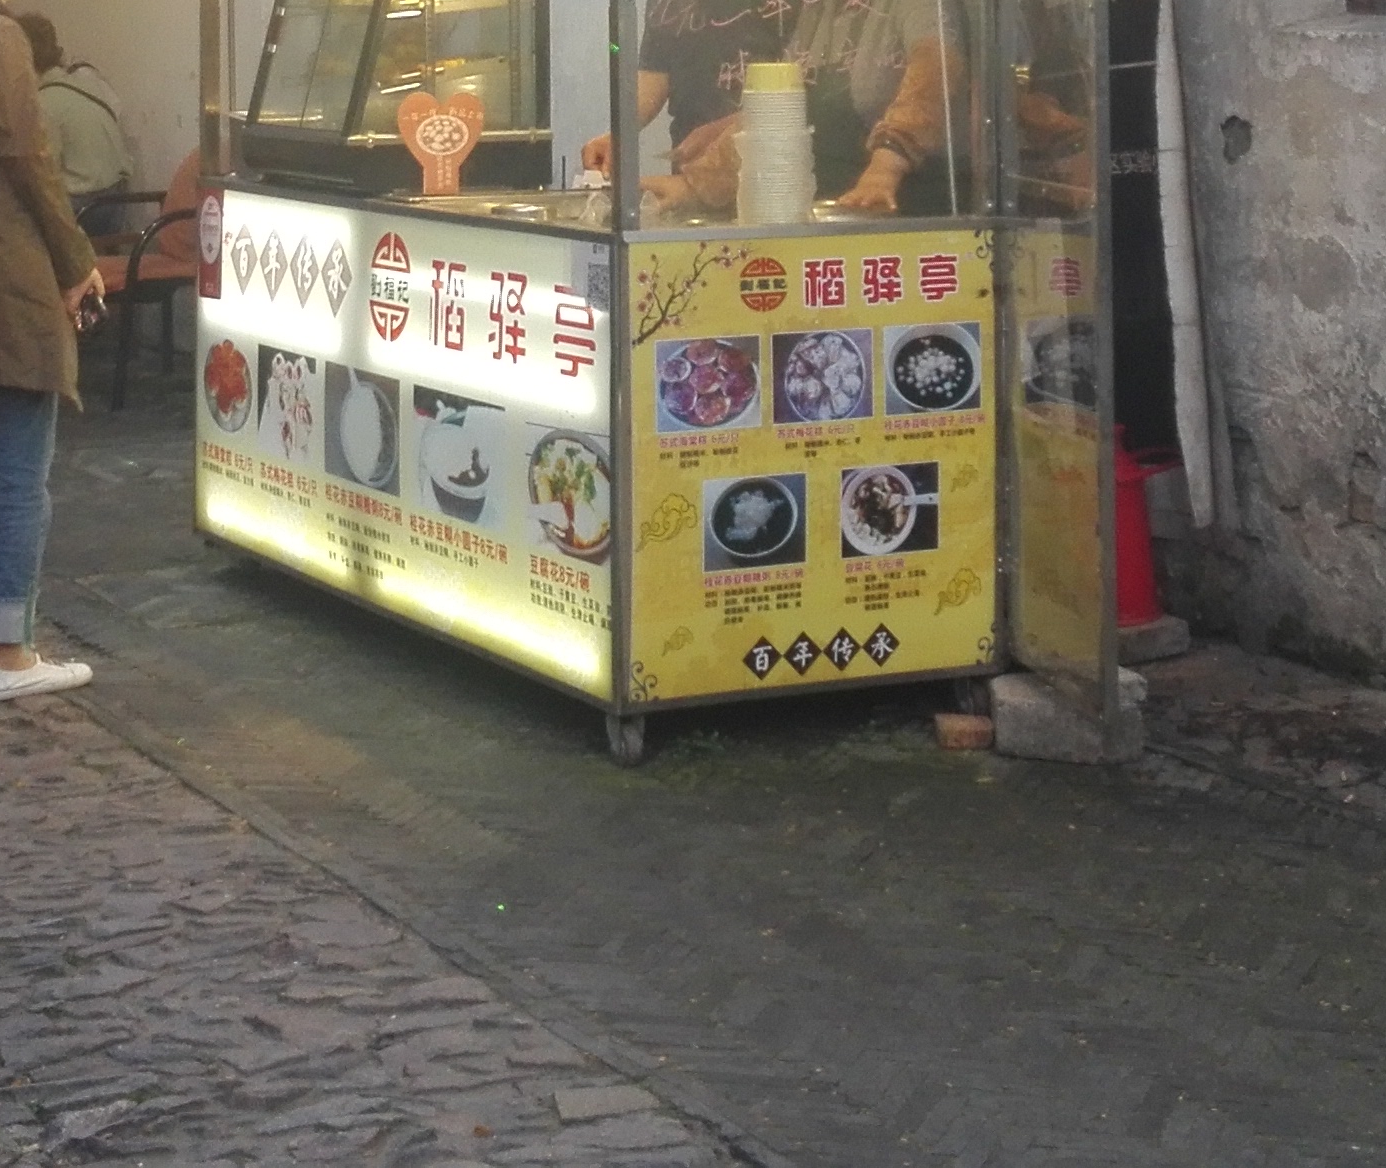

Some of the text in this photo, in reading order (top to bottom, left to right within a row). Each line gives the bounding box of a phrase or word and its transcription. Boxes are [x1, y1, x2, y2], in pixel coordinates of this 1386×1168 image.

[233, 234, 350, 302] 百年传承
[803, 254, 958, 308] 稻驿亭
[751, 630, 896, 674] 百年传承
